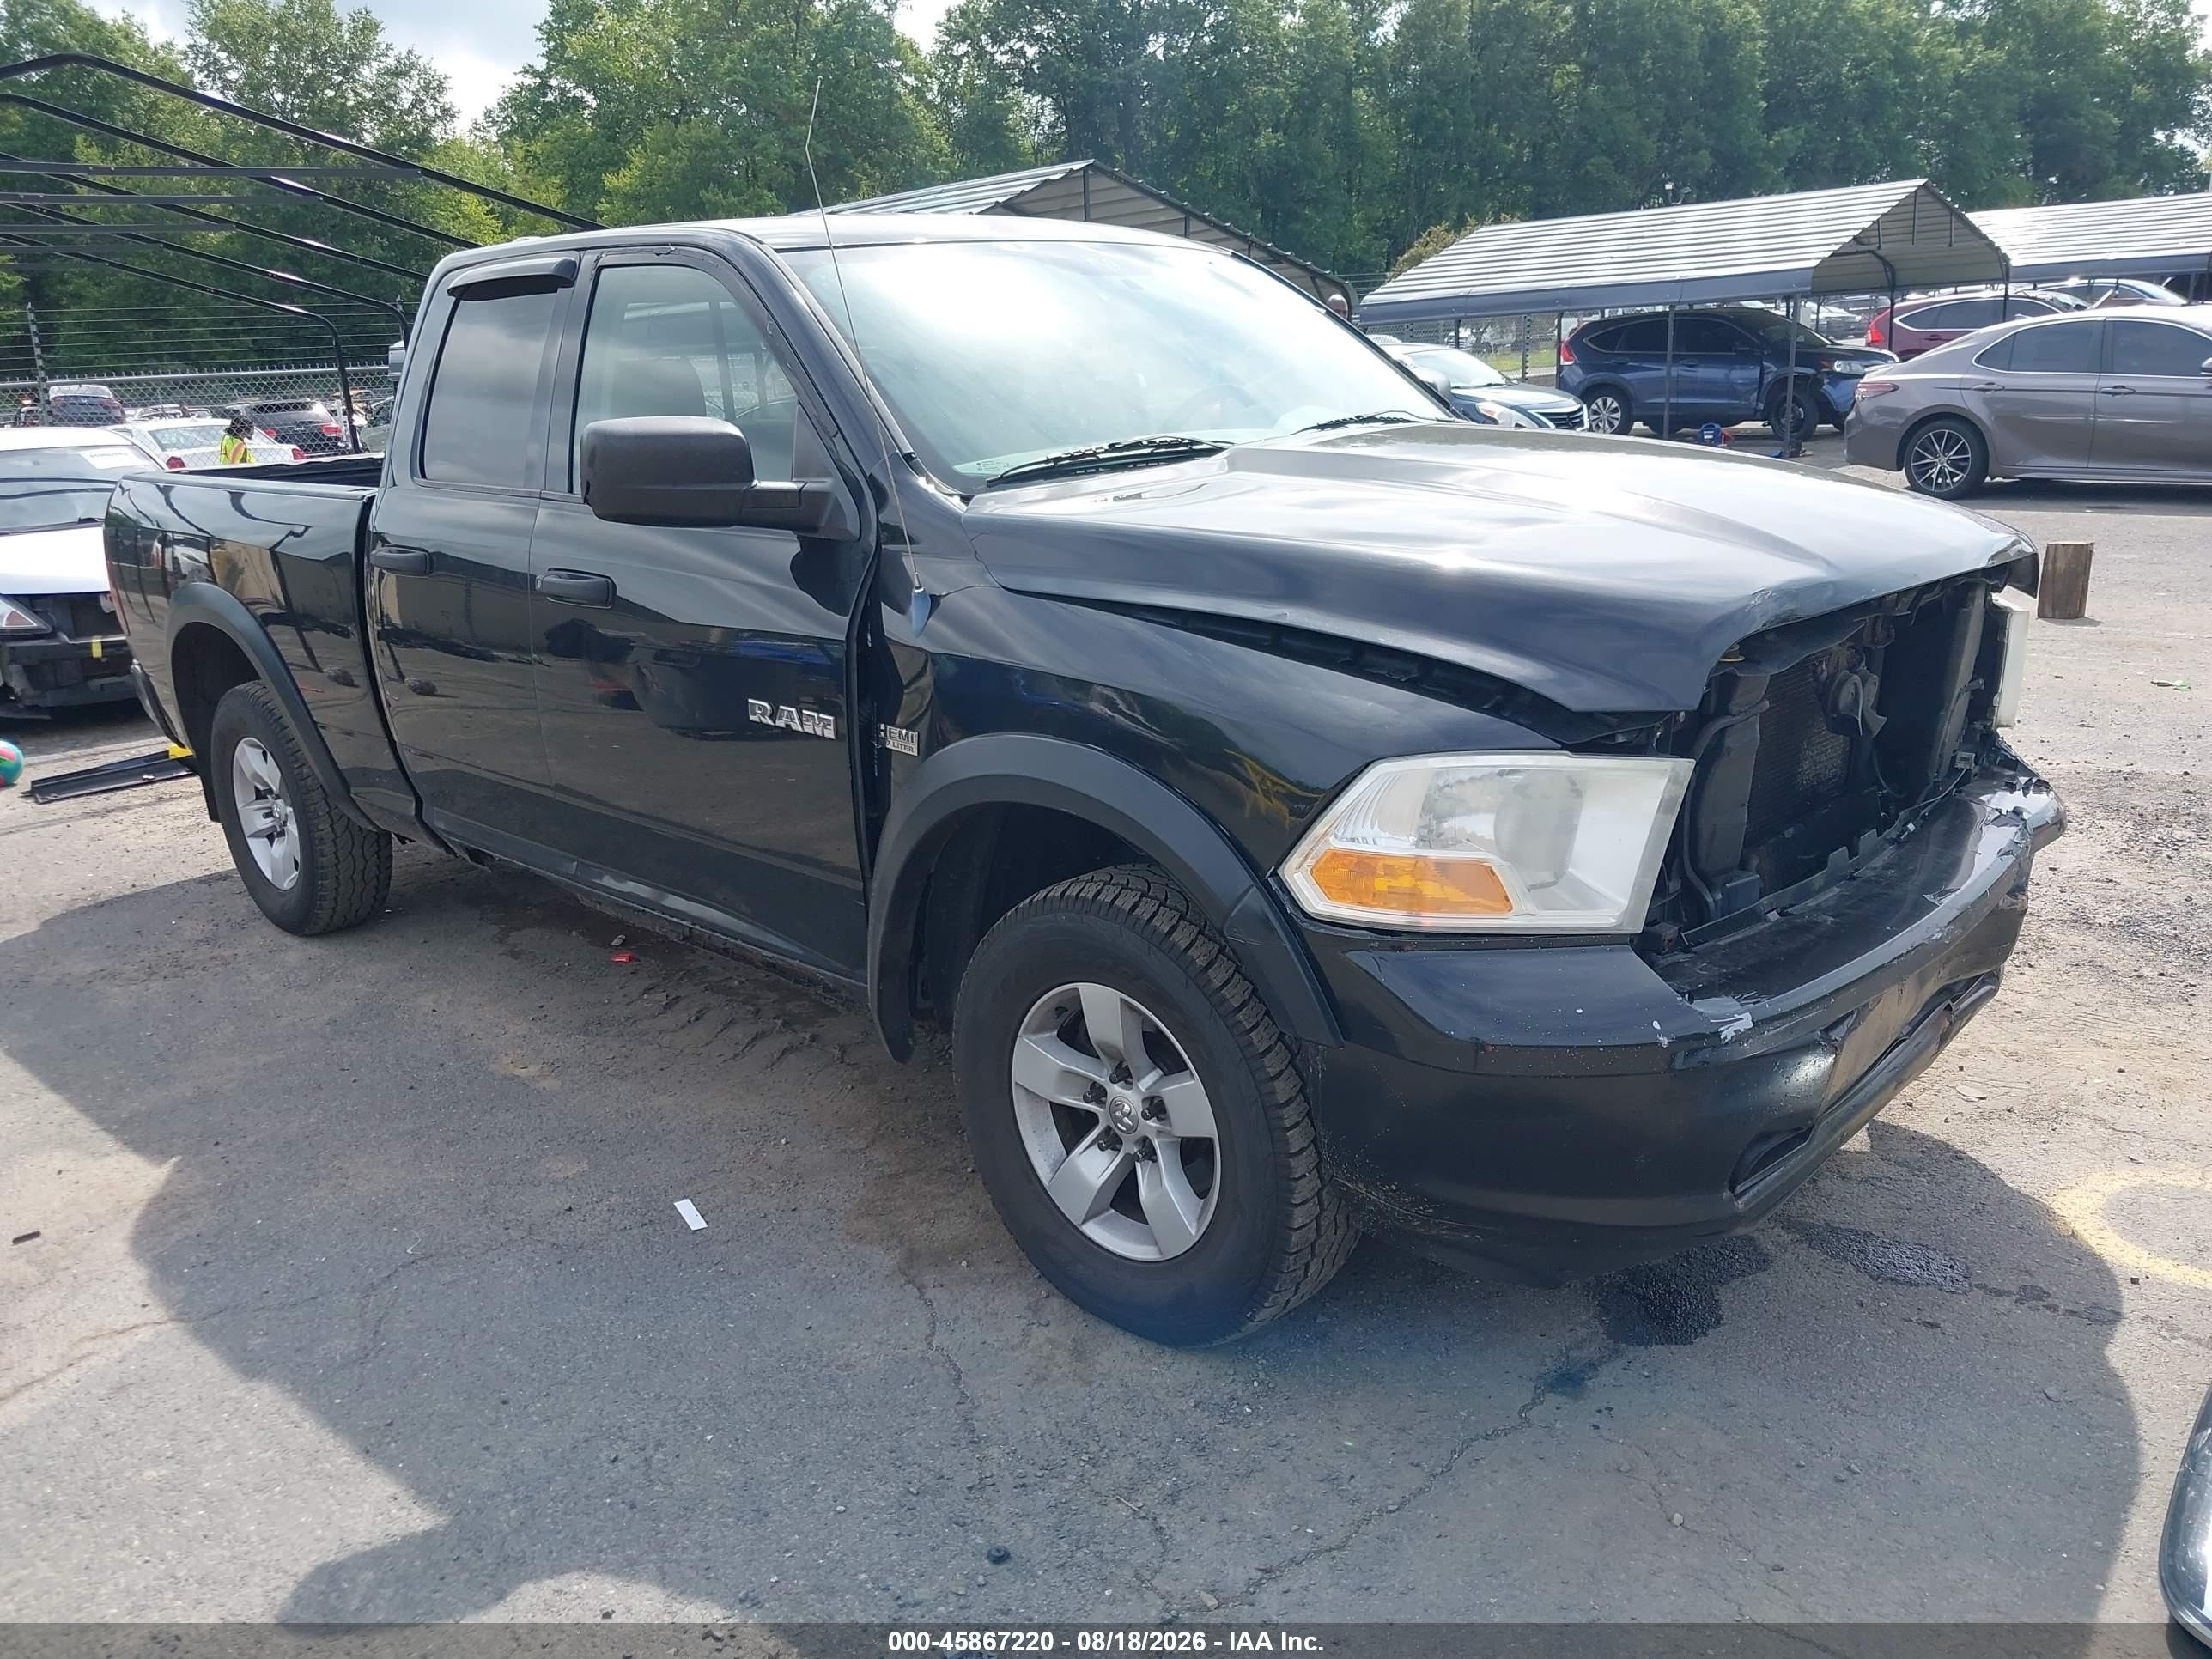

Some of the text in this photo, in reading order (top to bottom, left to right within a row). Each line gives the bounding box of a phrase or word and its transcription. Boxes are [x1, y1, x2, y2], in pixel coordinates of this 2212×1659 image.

[748, 698, 836, 739] RAM
[878, 723, 915, 743] HEMI
[892, 741, 915, 752] LITER
